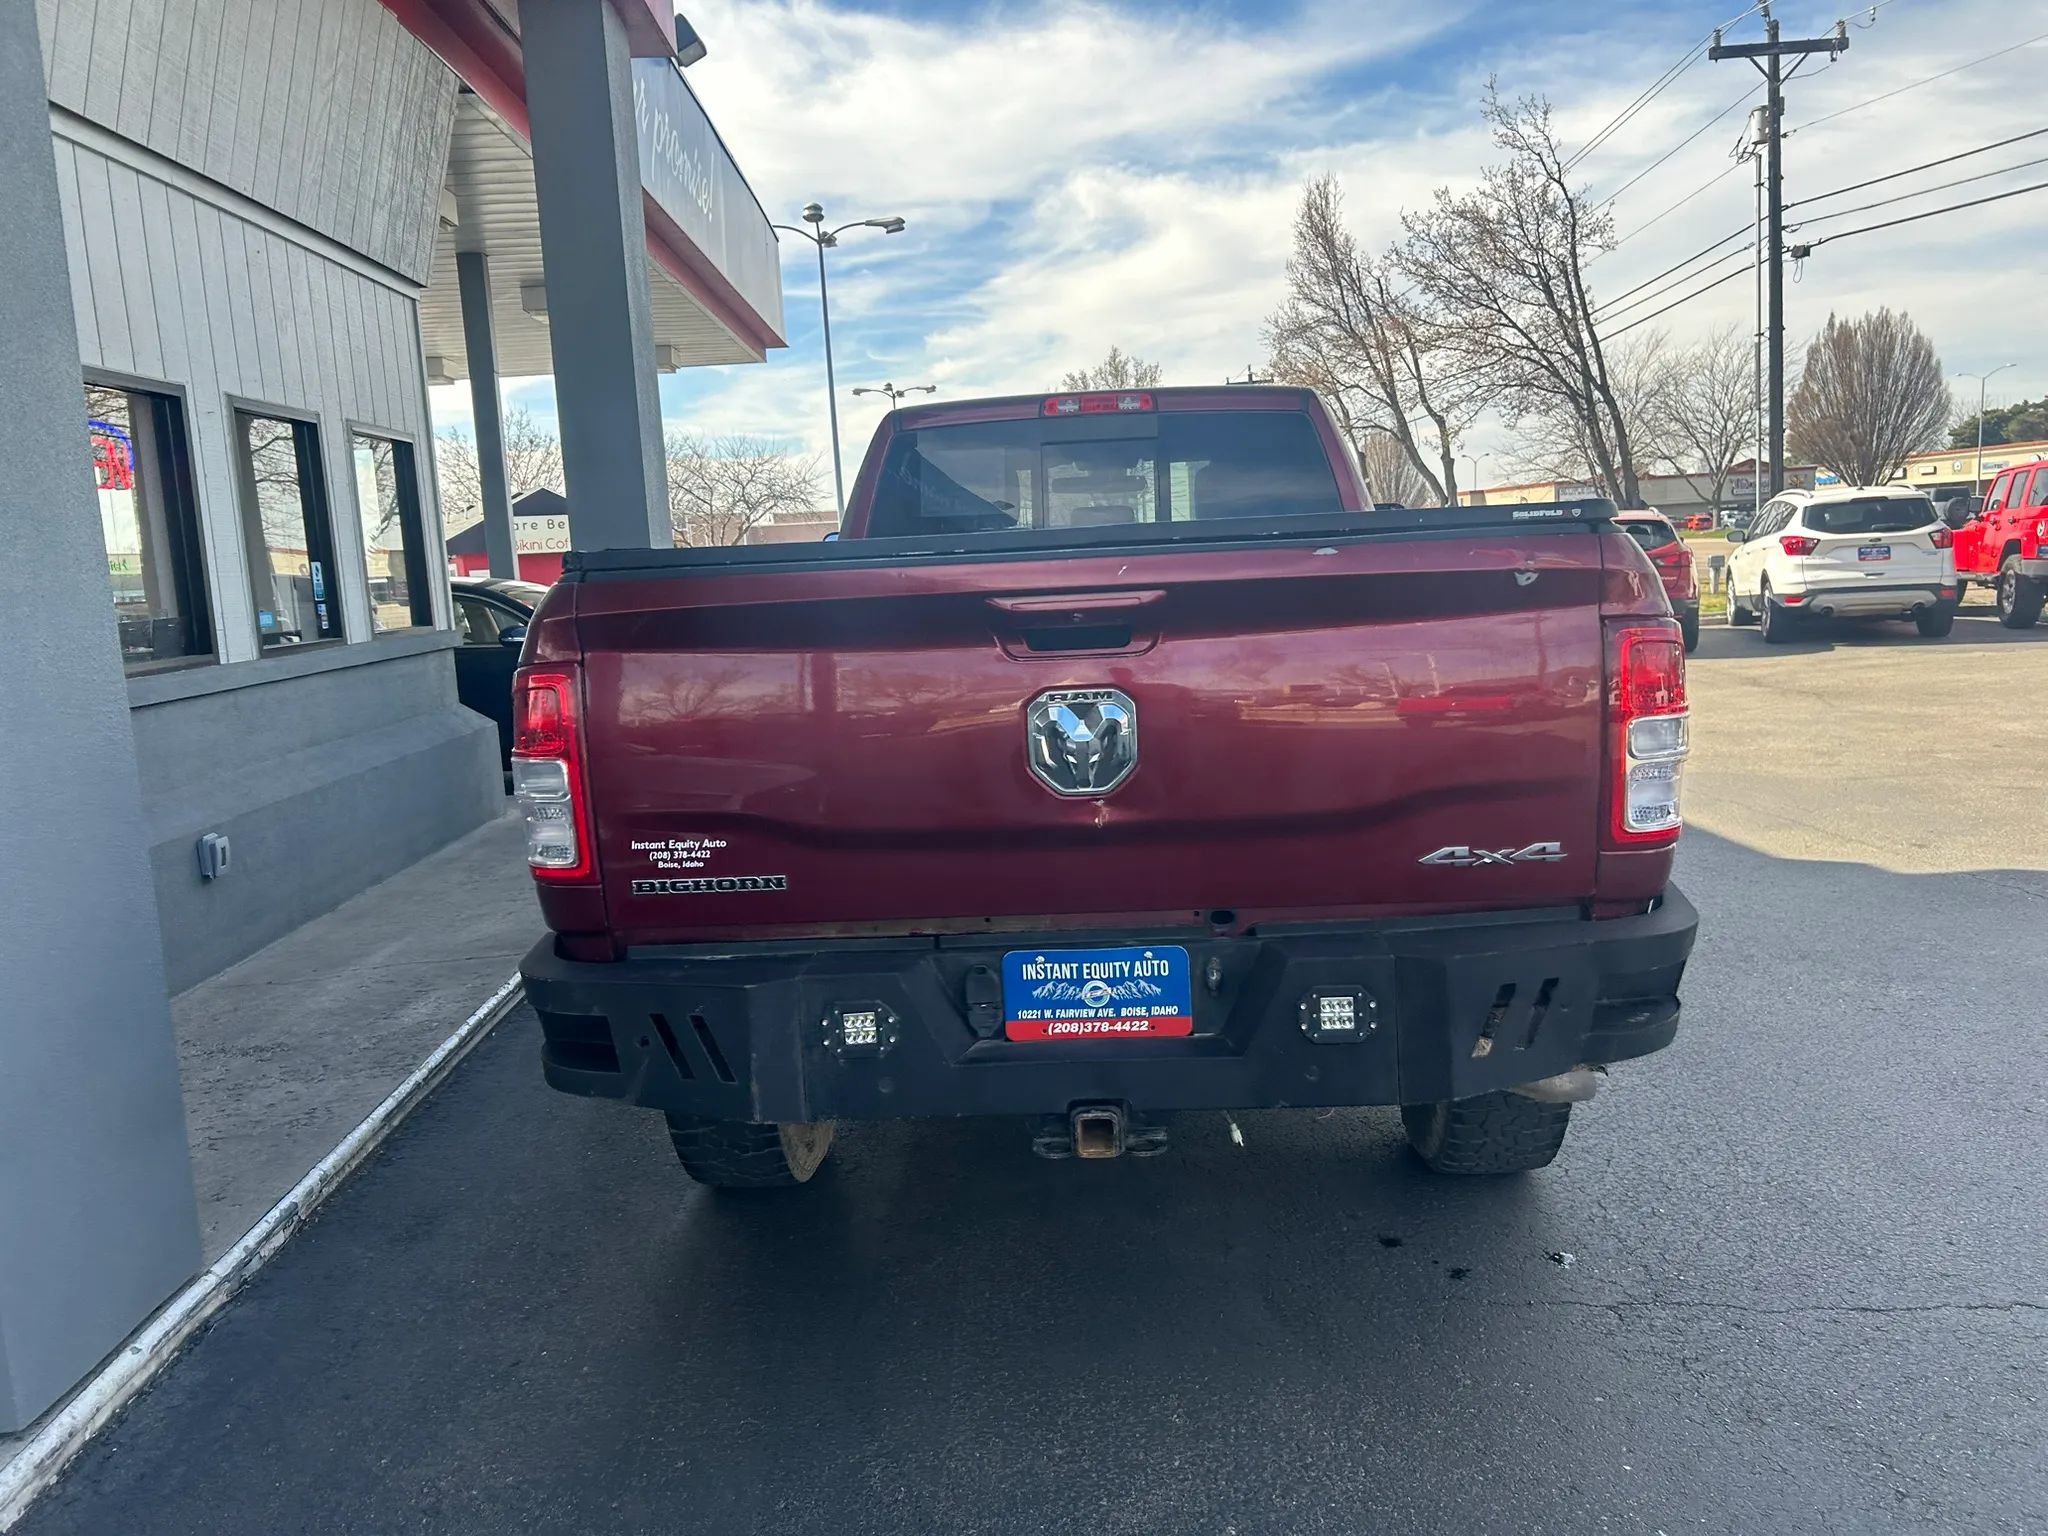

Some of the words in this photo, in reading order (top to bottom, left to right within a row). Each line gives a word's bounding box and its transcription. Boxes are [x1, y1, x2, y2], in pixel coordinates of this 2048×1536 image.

[631, 840, 666, 850] Instant
[668, 839, 700, 850] Equity
[702, 838, 727, 848] Auto
[649, 851, 671, 861] (208)
[673, 850, 711, 859] 378-4422
[658, 861, 681, 869] Boise,
[682, 860, 704, 868] Idaho
[632, 875, 787, 895] BIGHORN
[1022, 963, 1079, 980] INSTANT
[1083, 961, 1131, 979] EQUITY
[1133, 960, 1169, 977] AUTO
[1017, 1010, 1041, 1019] 10221
[1044, 1009, 1053, 1019] W.
[1055, 1008, 1098, 1019] FAIRVIEW
[1098, 1007, 1116, 1018] AVE.
[1120, 1006, 1149, 1018] BOISE,
[1151, 1005, 1179, 1016] IDAHO
[1048, 1020, 1149, 1035] (208)378-4422
